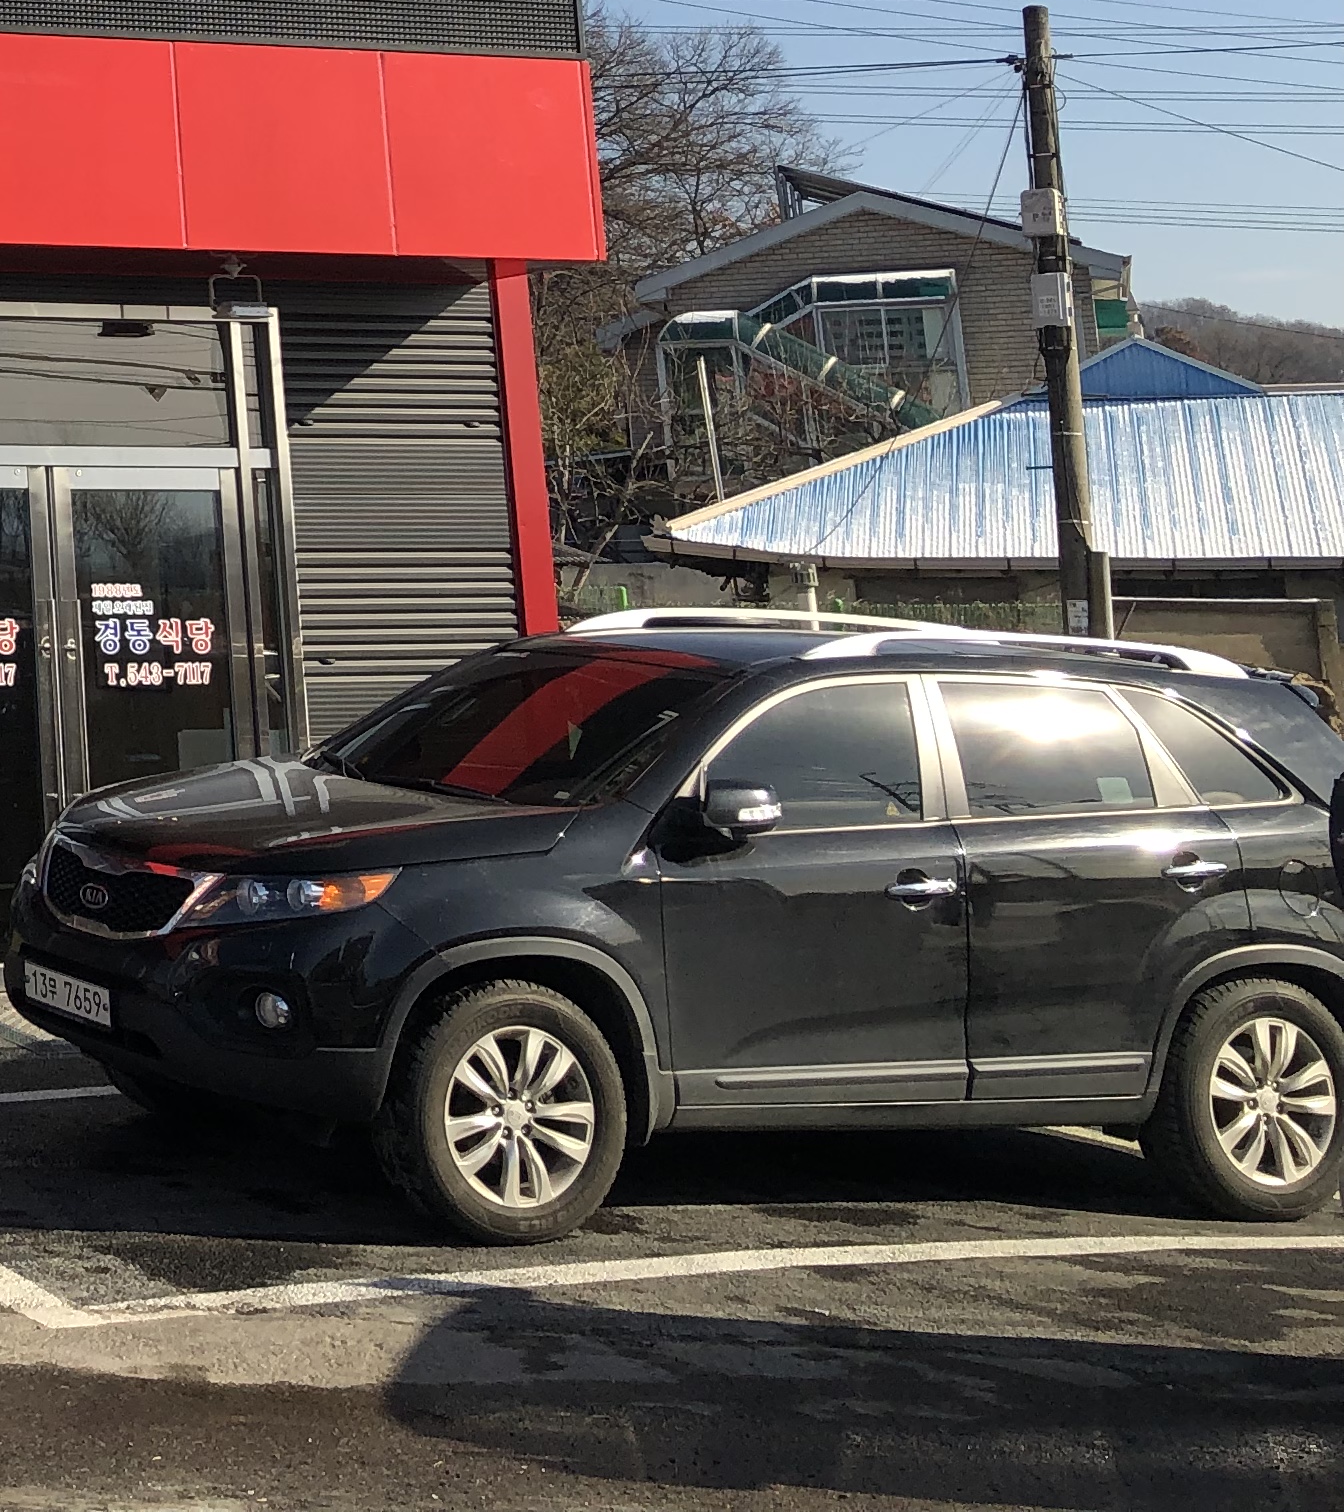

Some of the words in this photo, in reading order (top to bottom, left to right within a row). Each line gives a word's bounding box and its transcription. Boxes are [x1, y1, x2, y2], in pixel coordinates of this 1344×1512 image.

[94, 618, 215, 656] 경동식당
[104, 661, 213, 688] T.543-7117
[64, 981, 102, 1017] 7659
